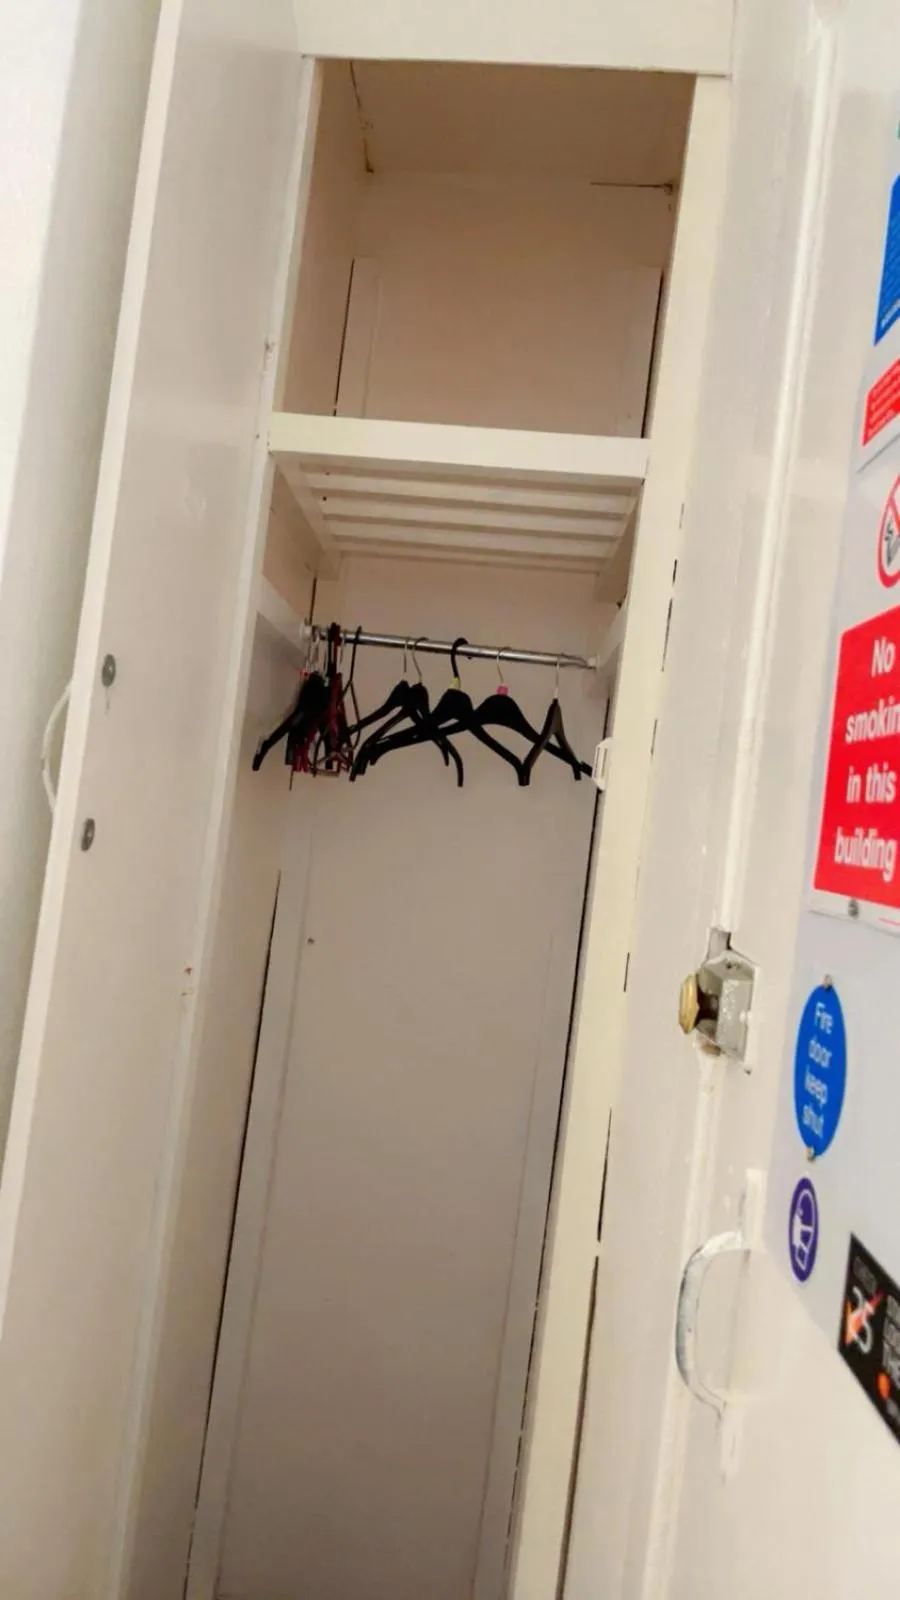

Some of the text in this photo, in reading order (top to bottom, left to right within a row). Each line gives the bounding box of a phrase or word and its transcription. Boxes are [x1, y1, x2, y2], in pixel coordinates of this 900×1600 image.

[871, 636, 896, 678] No
[845, 695, 900, 743] smokin
[846, 762, 897, 804] in this
[834, 827, 897, 882] building
[814, 1001, 834, 1035] Fire
[808, 1035, 832, 1068] door
[804, 1064, 828, 1109] keep
[802, 1101, 825, 1139] shut
